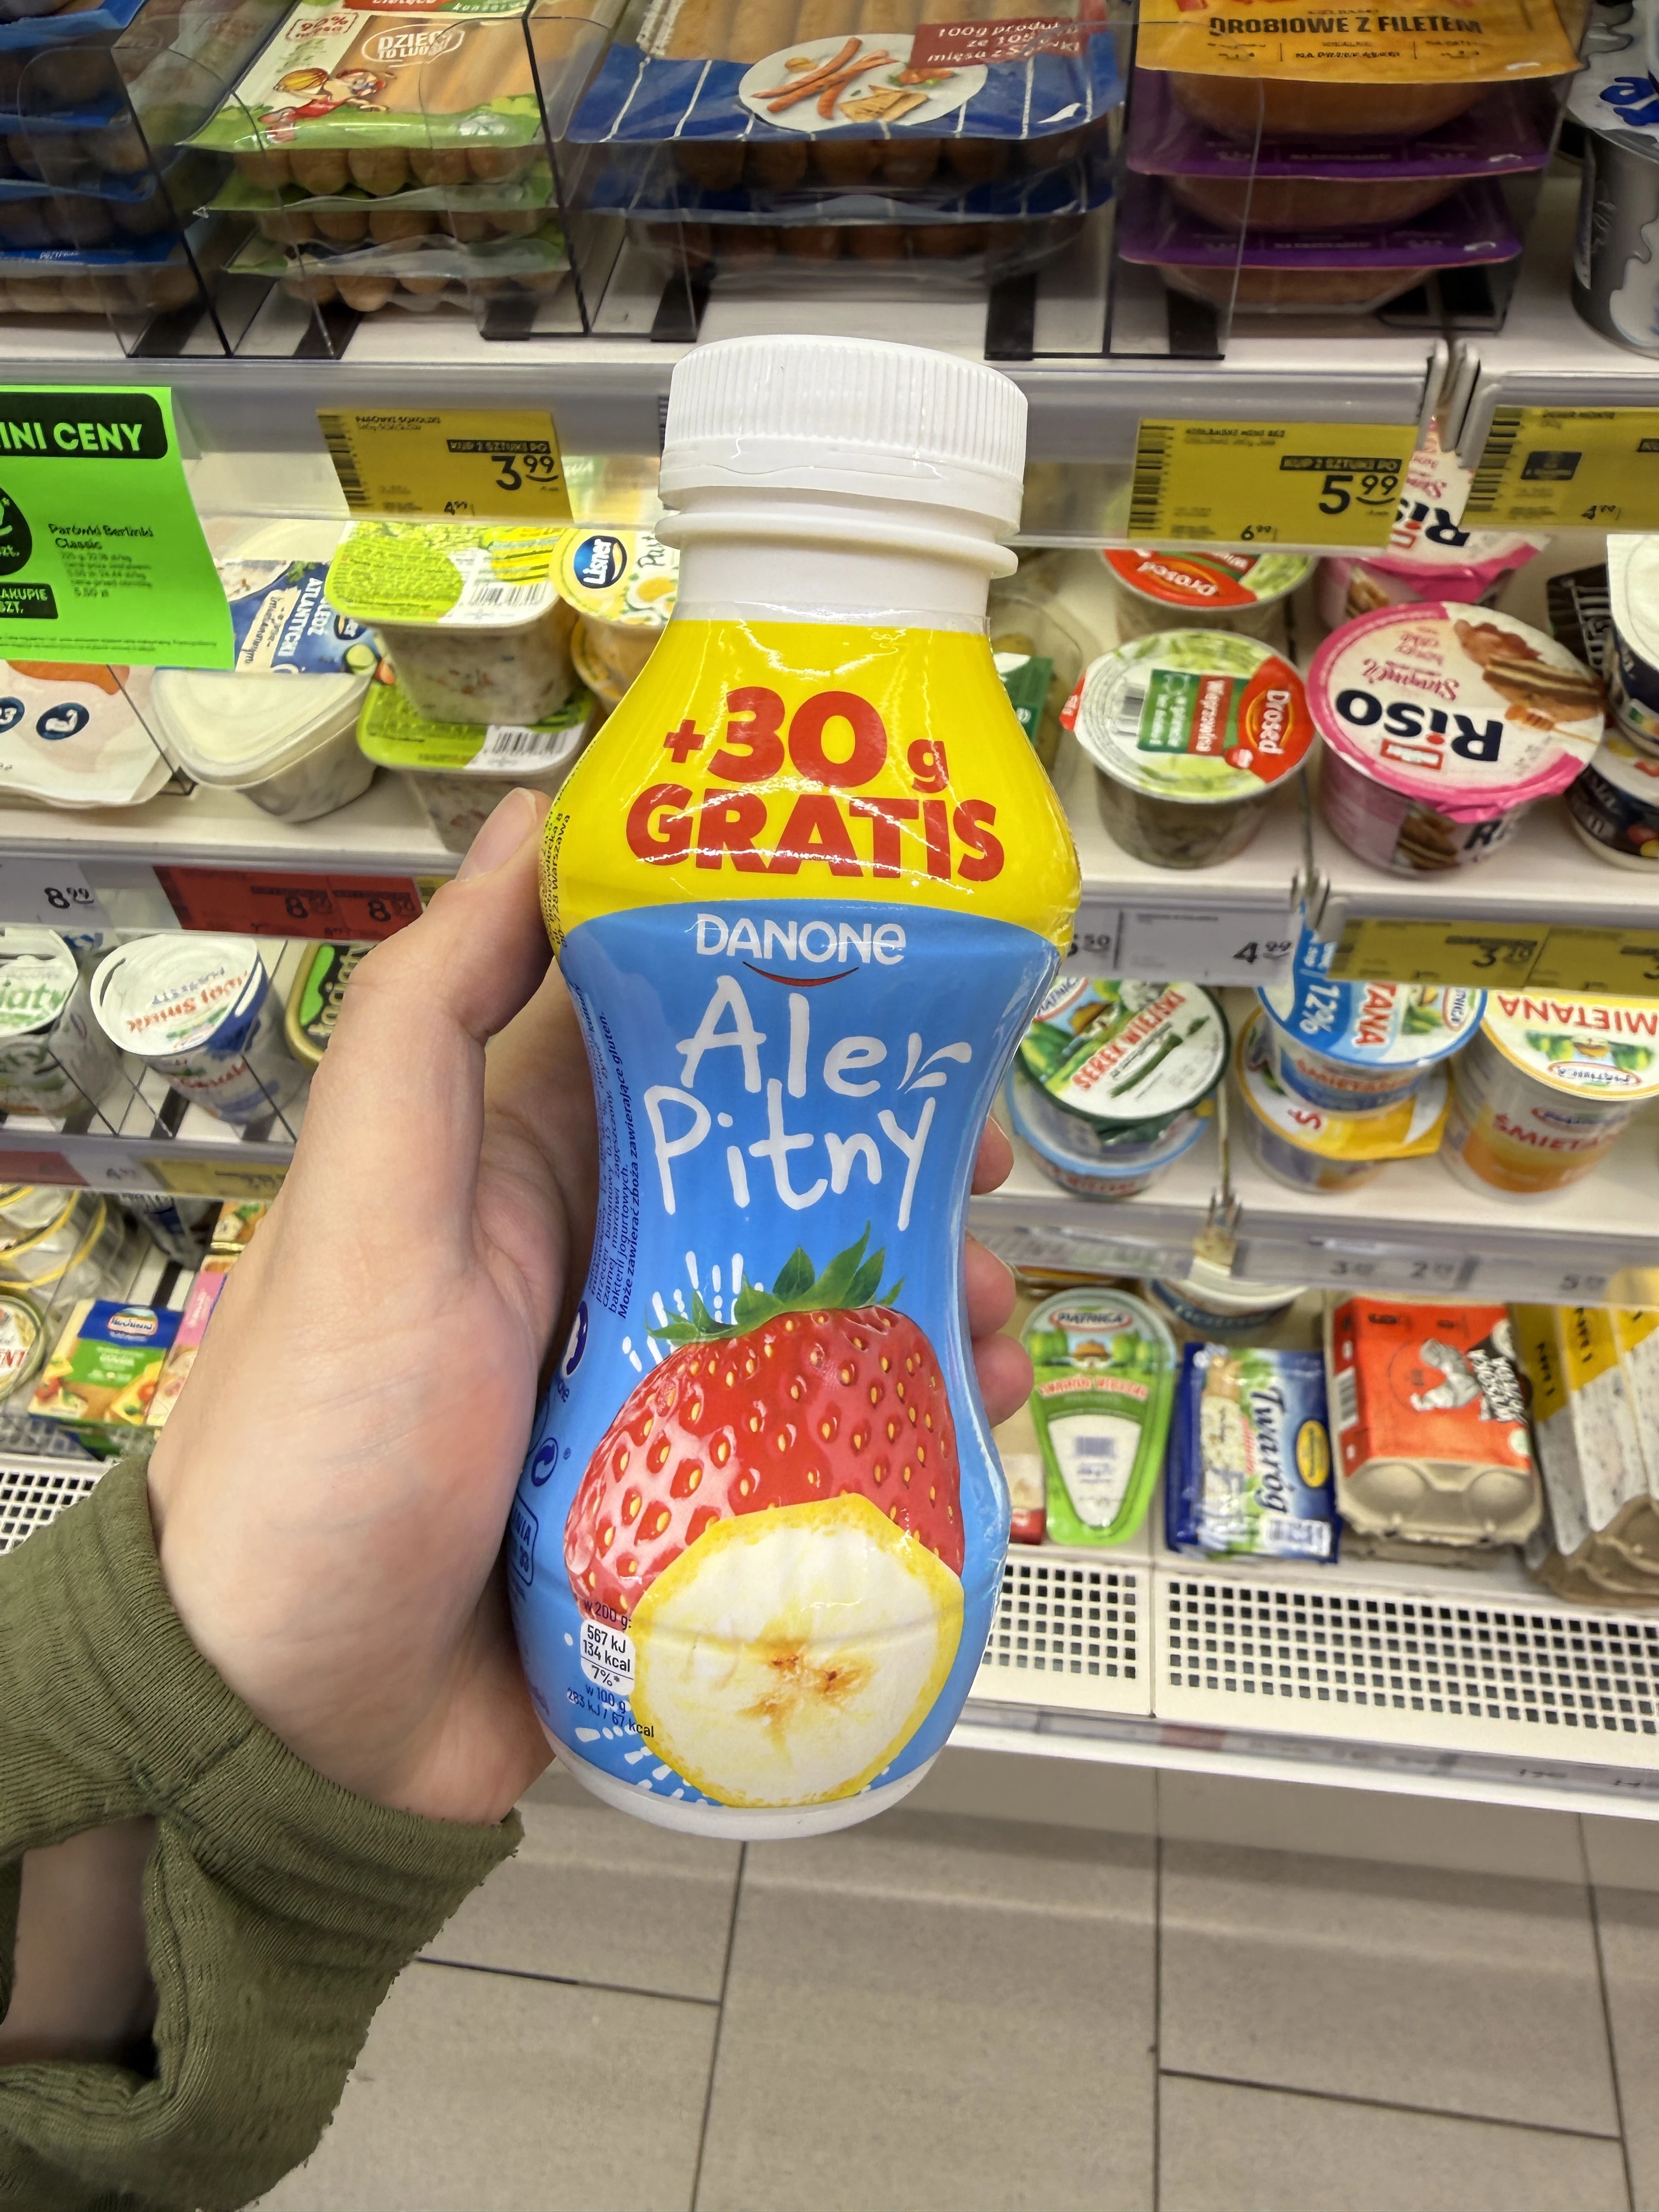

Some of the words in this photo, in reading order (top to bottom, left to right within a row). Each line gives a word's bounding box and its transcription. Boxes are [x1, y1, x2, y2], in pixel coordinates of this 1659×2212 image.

[1209, 16, 1350, 36] DROBIOWE
[1356, 16, 1370, 33] Z
[1378, 15, 1484, 35] FILETEM
[0, 422, 47, 450] INI
[53, 422, 142, 452] CENY
[582, 538, 612, 585] Lisner
[277, 577, 324, 657] ATLANTYCKI
[1258, 689, 1291, 755] Drosed
[906, 738, 949, 793] g
[552, 814, 571, 890] Warszawa
[625, 783, 1005, 882] GRATIS
[1122, 989, 1187, 1052] WIEJSKI
[1299, 983, 1341, 1035] 12%
[1353, 984, 1397, 1047] TANA
[1498, 995, 1658, 1037] MIETANA
[599, 1011, 623, 1065] gluten.
[676, 975, 887, 1098] Ale
[1070, 1037, 1126, 1091] SEREK
[615, 1068, 638, 1159] zawierające
[644, 1078, 936, 1231] Pitny
[629, 1161, 640, 1207] zboża
[608, 1254, 625, 1314] bakterii
[619, 1163, 629, 1259] jogurtowych.
[611, 1187, 620, 1250] marchwi
[627, 1206, 640, 1274] zawierać
[617, 1279, 633, 1319] Może
[1250, 1386, 1295, 1513] Twaróg
[586, 1623, 608, 1646] 567
[611, 1634, 627, 1655] kJ
[595, 1601, 617, 1623] 200
[620, 1615, 632, 1631] g:
[583, 1639, 602, 1661] 134
[604, 1650, 631, 1673] kcal
[588, 1702, 601, 1717] kJ
[611, 1713, 625, 1728] 67
[628, 1717, 654, 1739] kcal
[596, 1686, 616, 1704] 100
[618, 1700, 627, 1715] g
